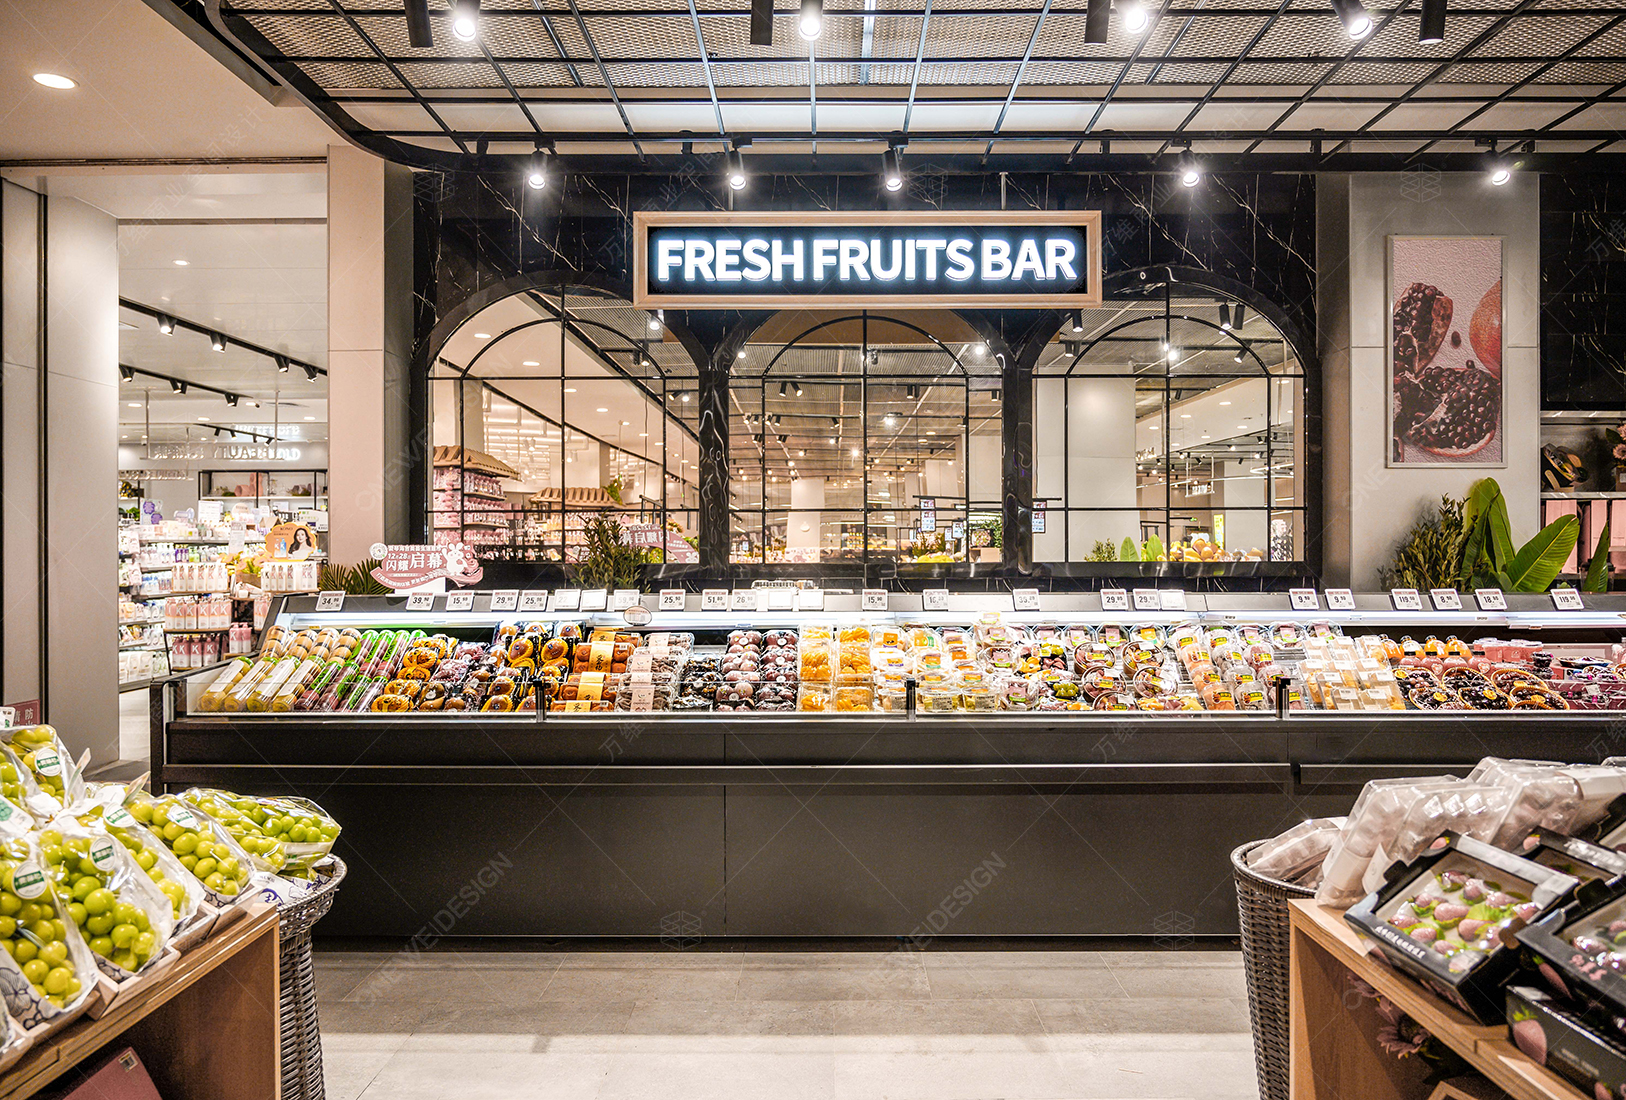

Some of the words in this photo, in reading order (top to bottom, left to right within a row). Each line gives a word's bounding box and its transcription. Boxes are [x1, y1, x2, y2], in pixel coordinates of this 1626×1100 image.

[658, 239, 804, 282] FRESH
[813, 239, 975, 282] FRUITS
[981, 239, 1078, 282] BAR
